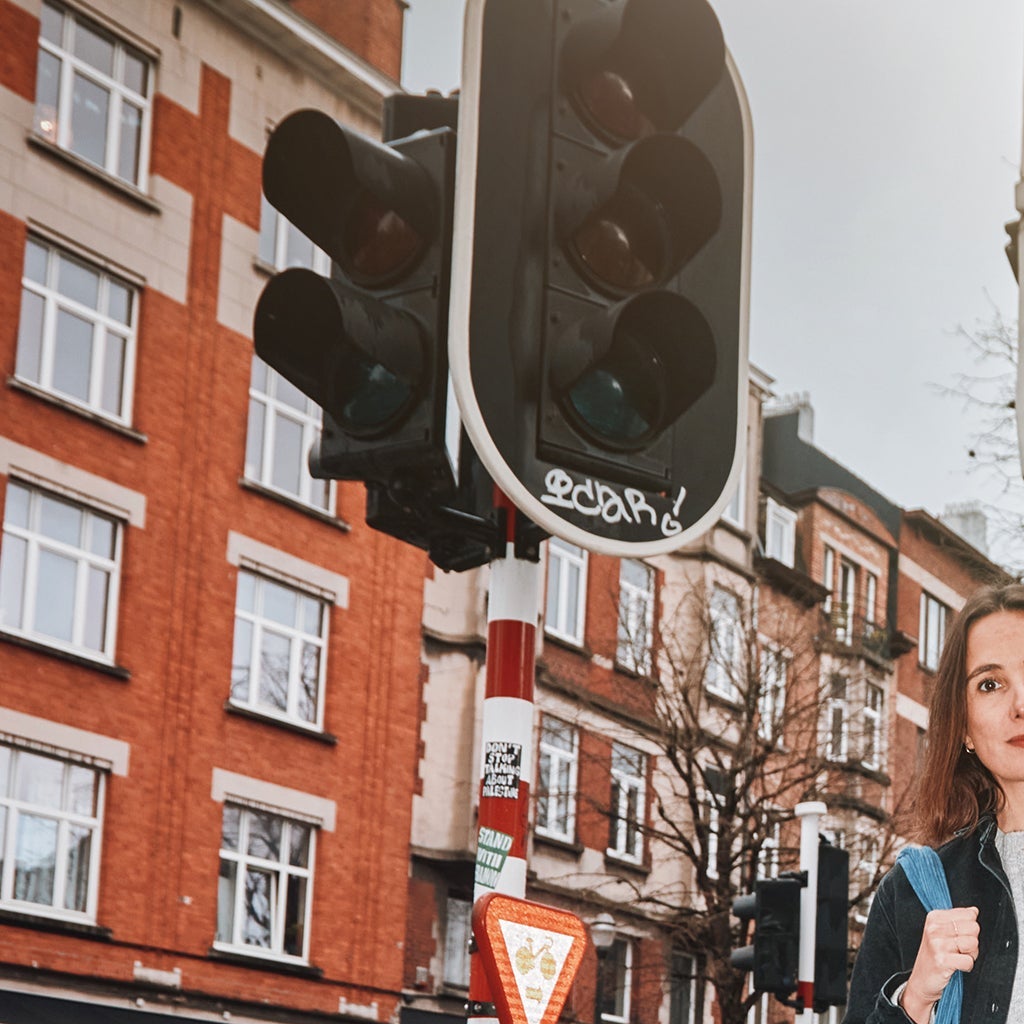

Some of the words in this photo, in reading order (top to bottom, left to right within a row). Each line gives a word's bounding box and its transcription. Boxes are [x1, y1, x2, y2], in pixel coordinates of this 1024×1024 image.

[485, 742, 521, 756] DON'T
[487, 753, 515, 764] STOP
[485, 773, 514, 786] ABOUT
